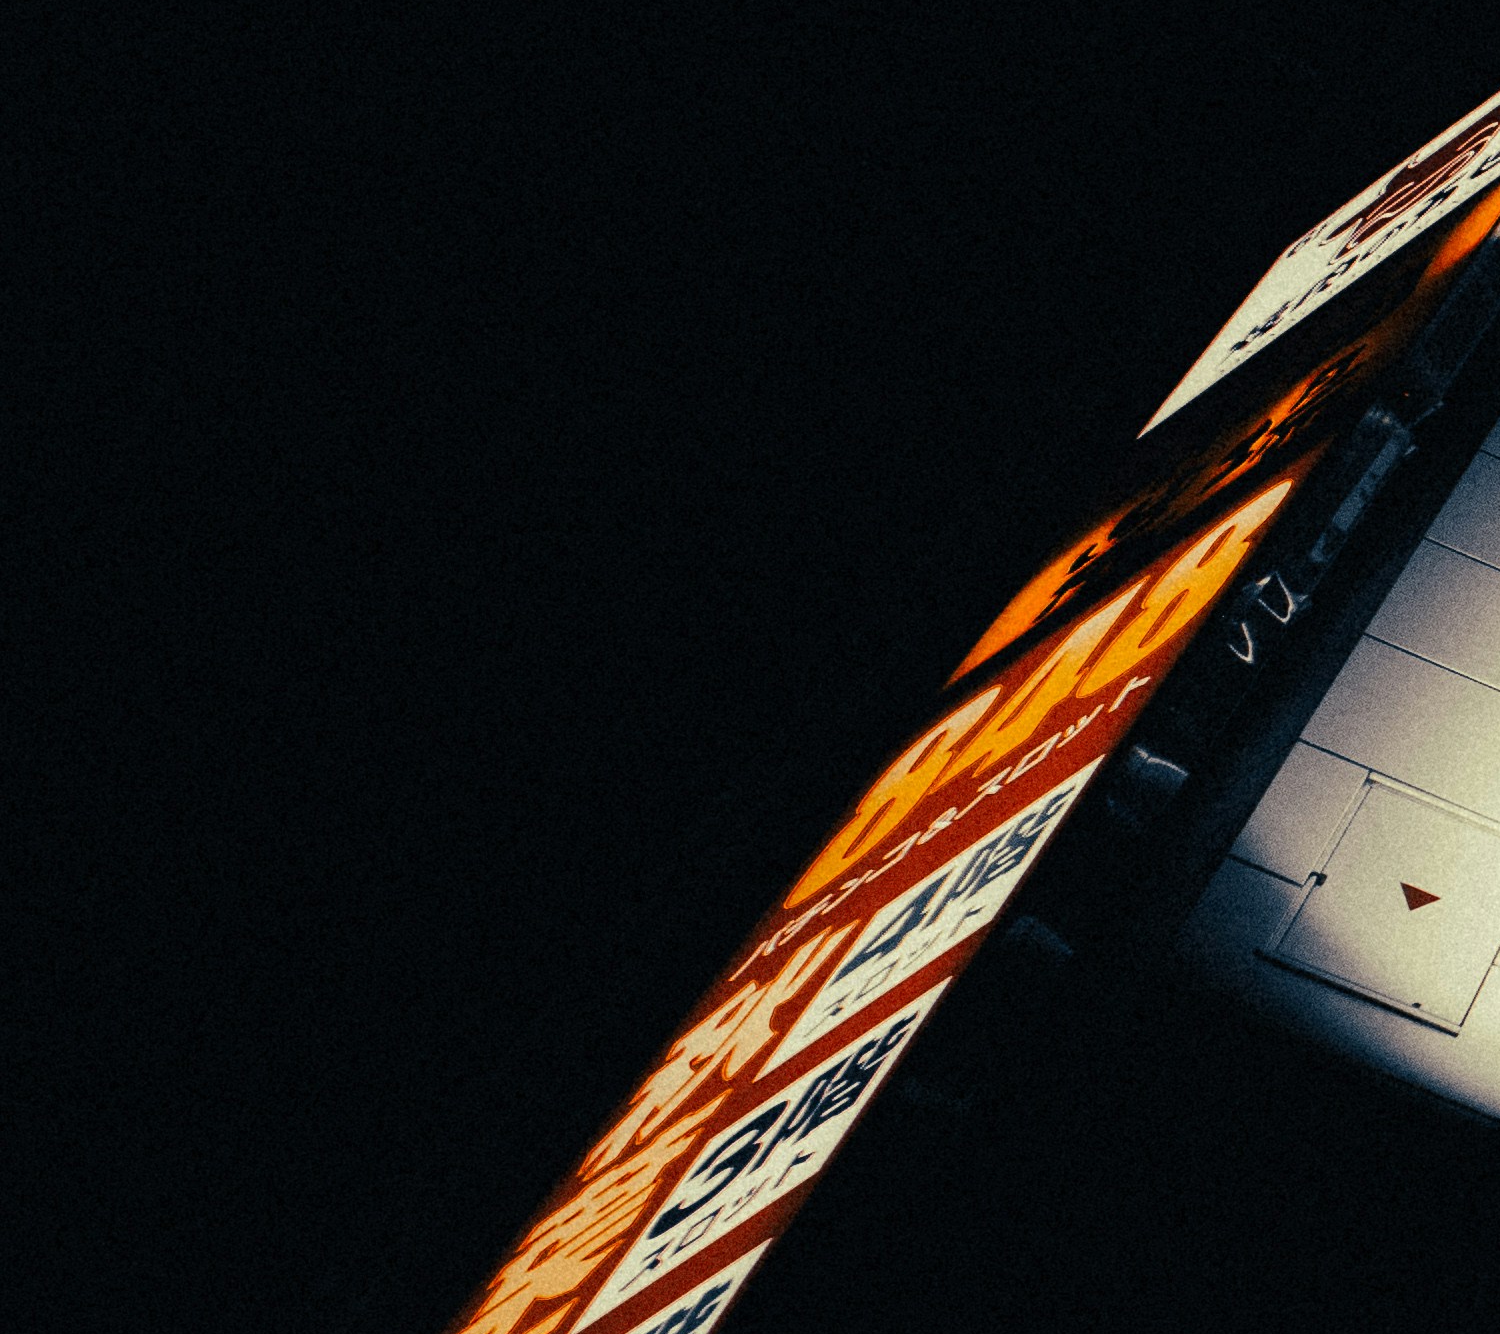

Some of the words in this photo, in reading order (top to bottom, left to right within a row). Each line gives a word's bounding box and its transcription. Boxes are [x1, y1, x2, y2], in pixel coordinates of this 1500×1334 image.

[784, 478, 1294, 910] 848
[728, 674, 1151, 982] パチンコ&スロット
[829, 785, 1075, 986] 4階
[803, 906, 983, 1040] スロット
[620, 1151, 814, 1291] スロット
[646, 1010, 919, 1240] 3階
